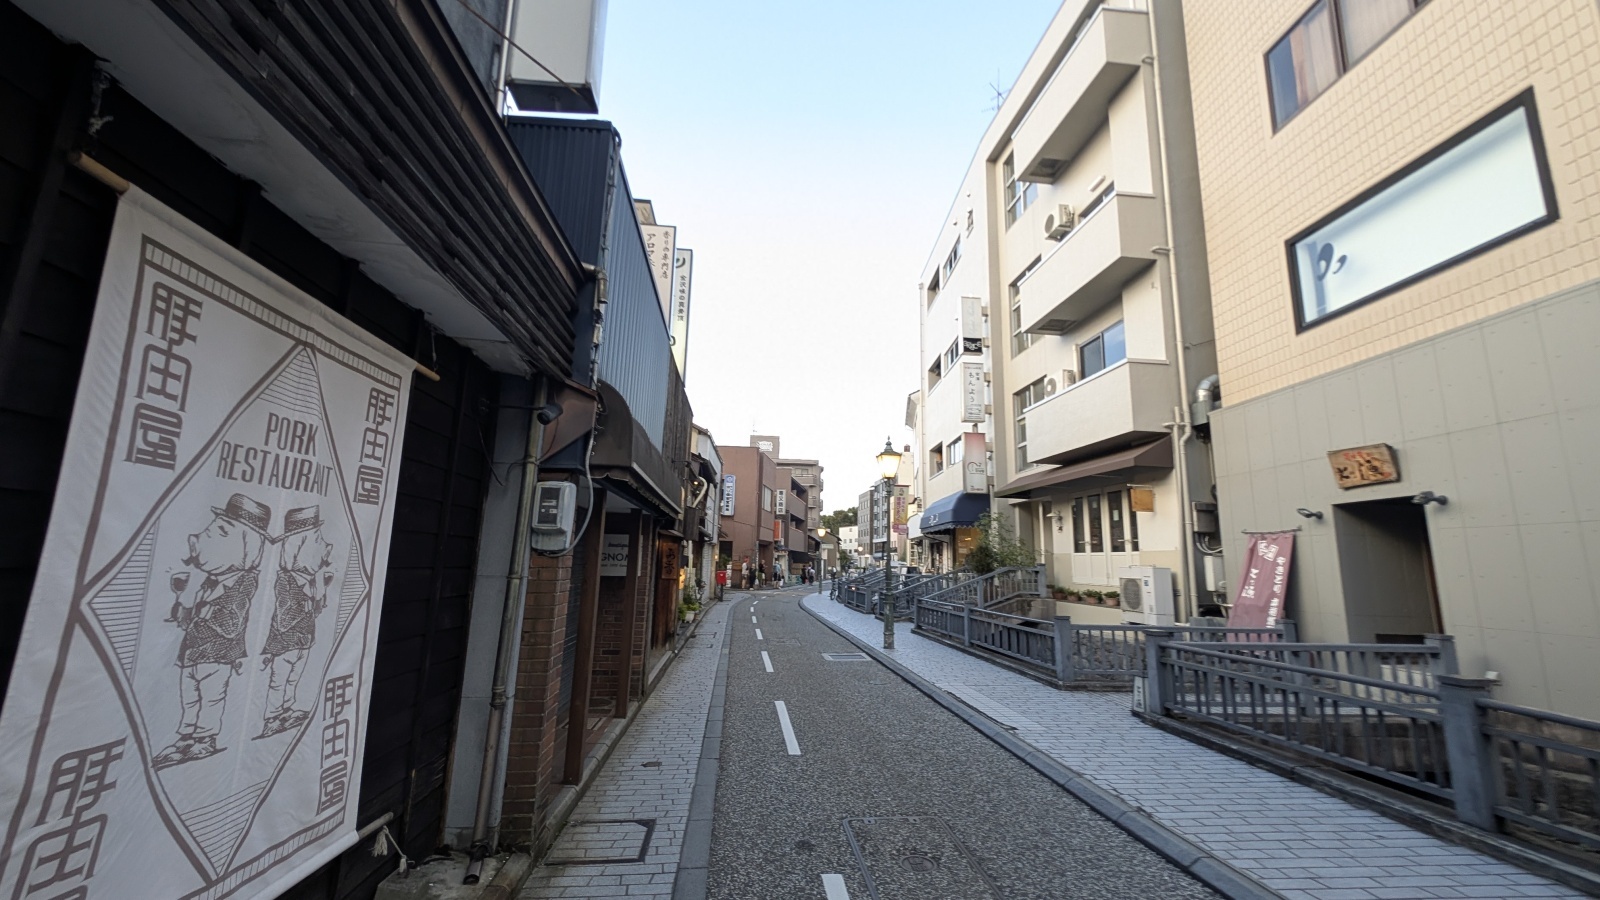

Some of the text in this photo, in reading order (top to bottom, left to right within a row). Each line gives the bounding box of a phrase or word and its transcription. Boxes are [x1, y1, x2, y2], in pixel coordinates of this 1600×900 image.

[660, 230, 671, 280] 香りの専門店
[968, 372, 976, 403] もんよう
[264, 412, 319, 458] PORK
[216, 442, 334, 498] RESTAURANT
